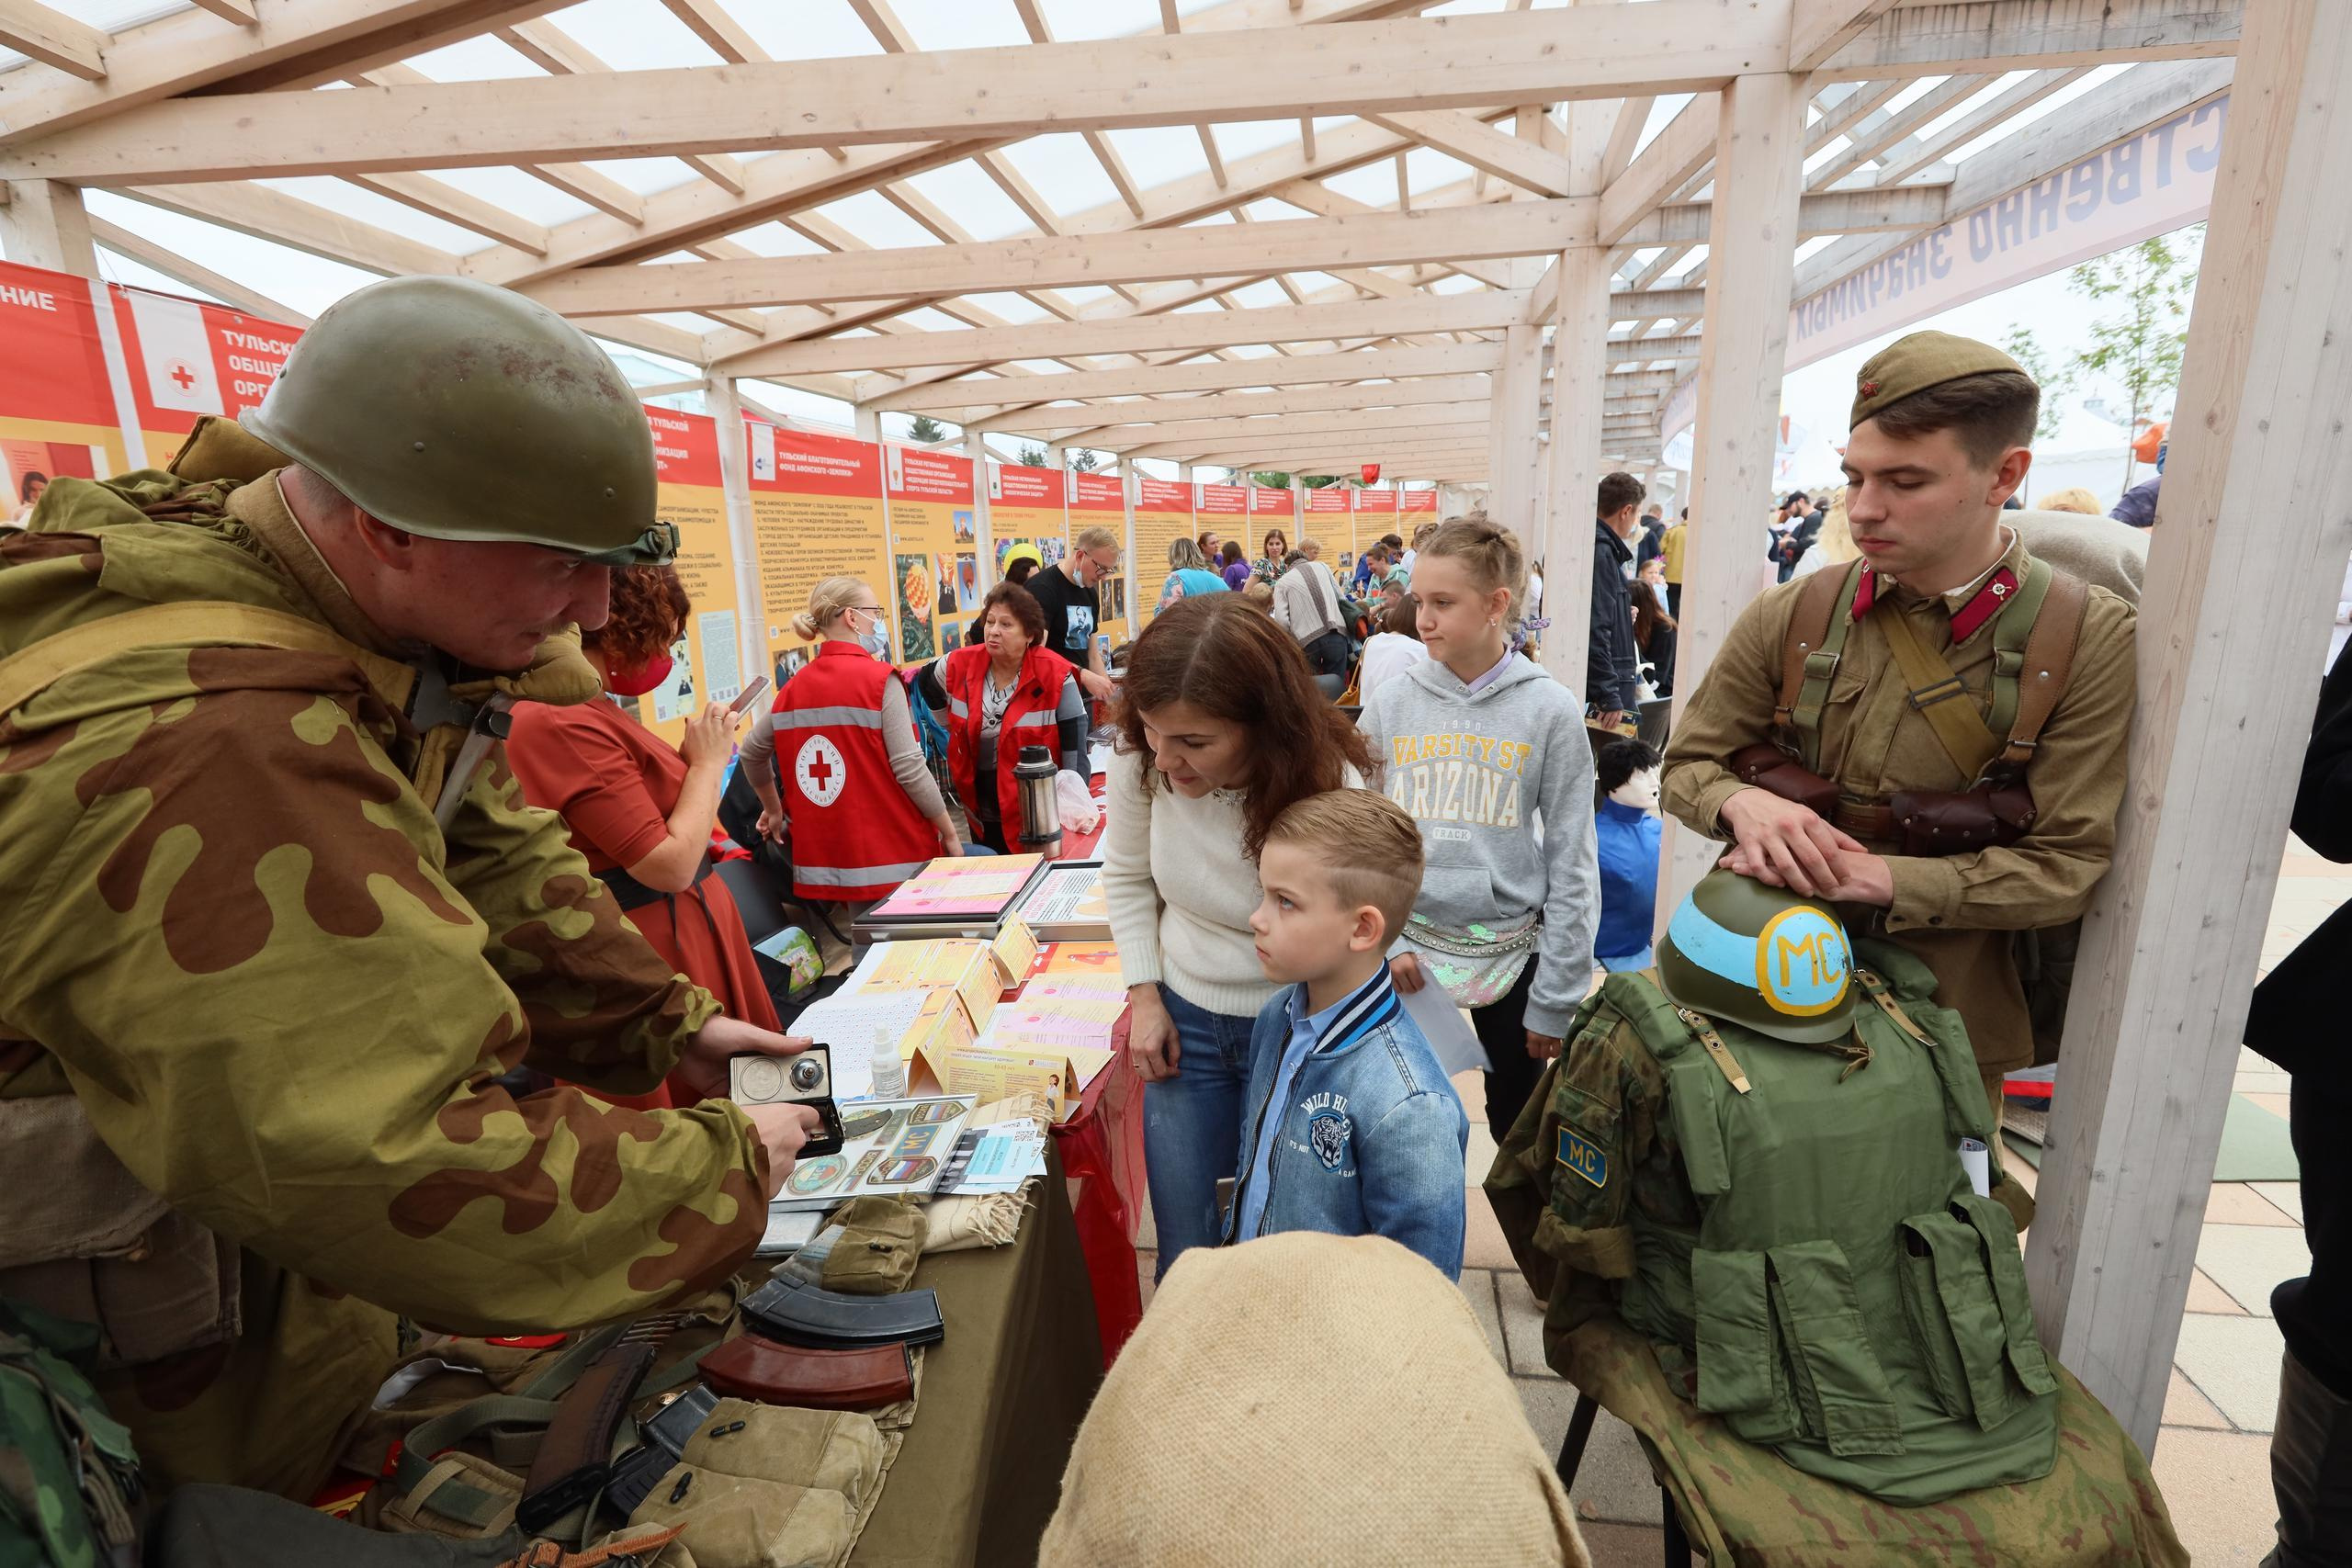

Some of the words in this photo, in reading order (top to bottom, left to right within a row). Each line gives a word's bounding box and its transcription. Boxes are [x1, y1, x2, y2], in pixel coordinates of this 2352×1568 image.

[0, 285, 57, 311] НИЕ
[1392, 732, 1497, 769] VARSITY
[1498, 739, 1532, 776] ST
[1391, 760, 1521, 828] ARIZONA
[1434, 829, 1469, 840] TRACK
[1300, 1091, 1329, 1115] WILD
[1298, 1144, 1310, 1155] NOT
